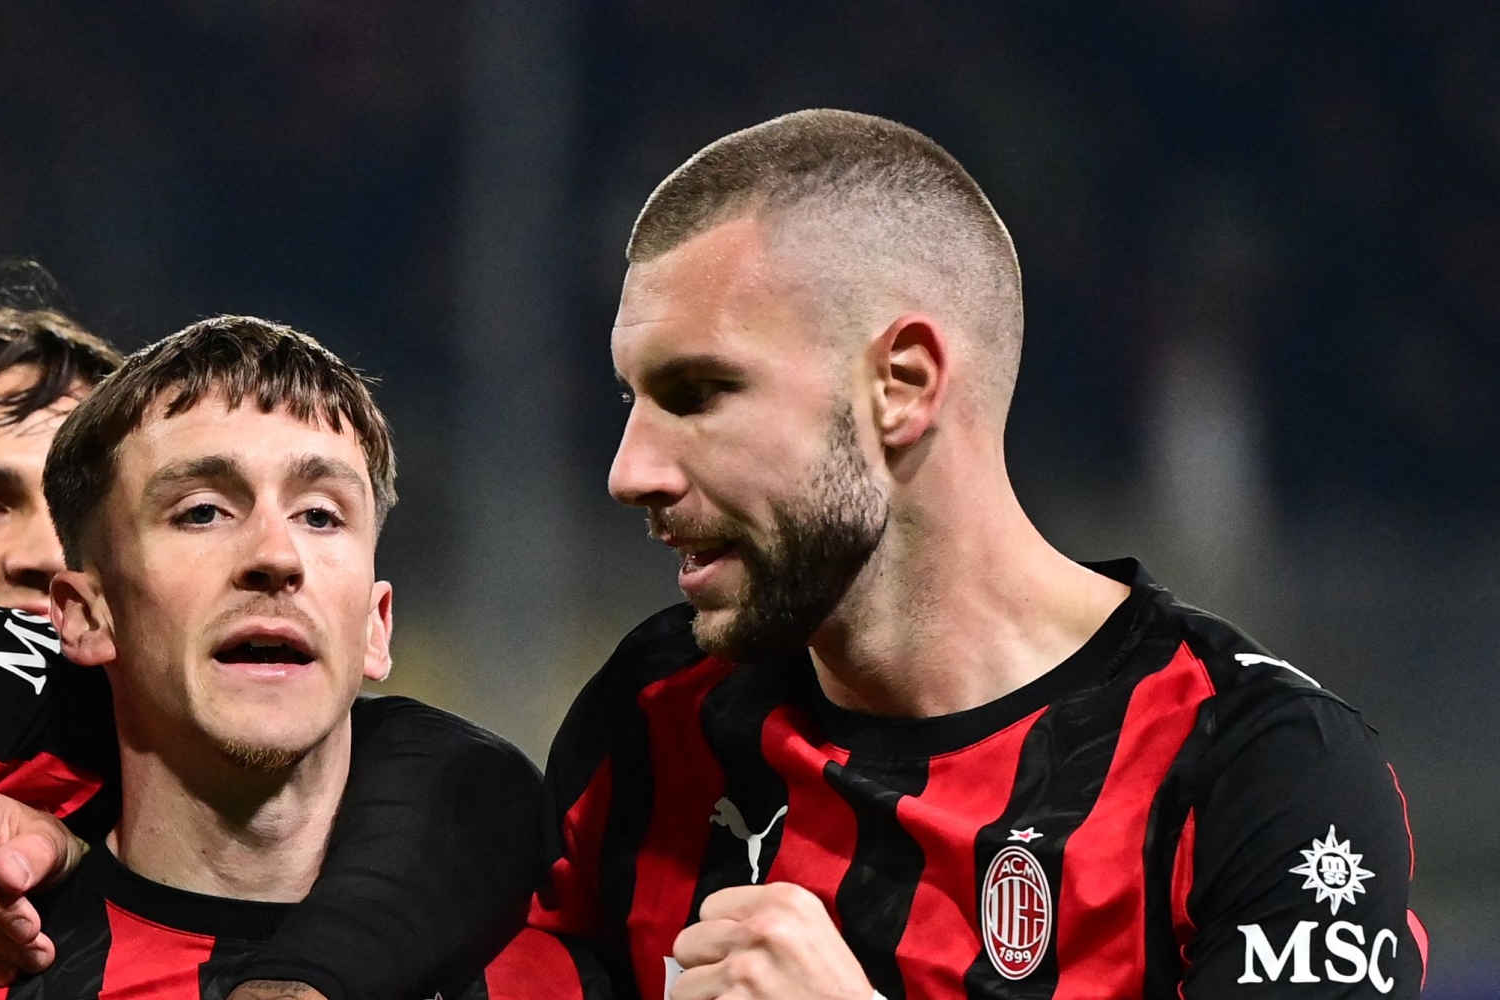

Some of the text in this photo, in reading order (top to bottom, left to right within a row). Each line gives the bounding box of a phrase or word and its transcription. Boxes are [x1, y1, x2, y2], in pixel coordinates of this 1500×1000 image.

[997, 857, 1037, 883] ACM
[998, 946, 1032, 963] 1899
[1237, 920, 1399, 994] MSC
